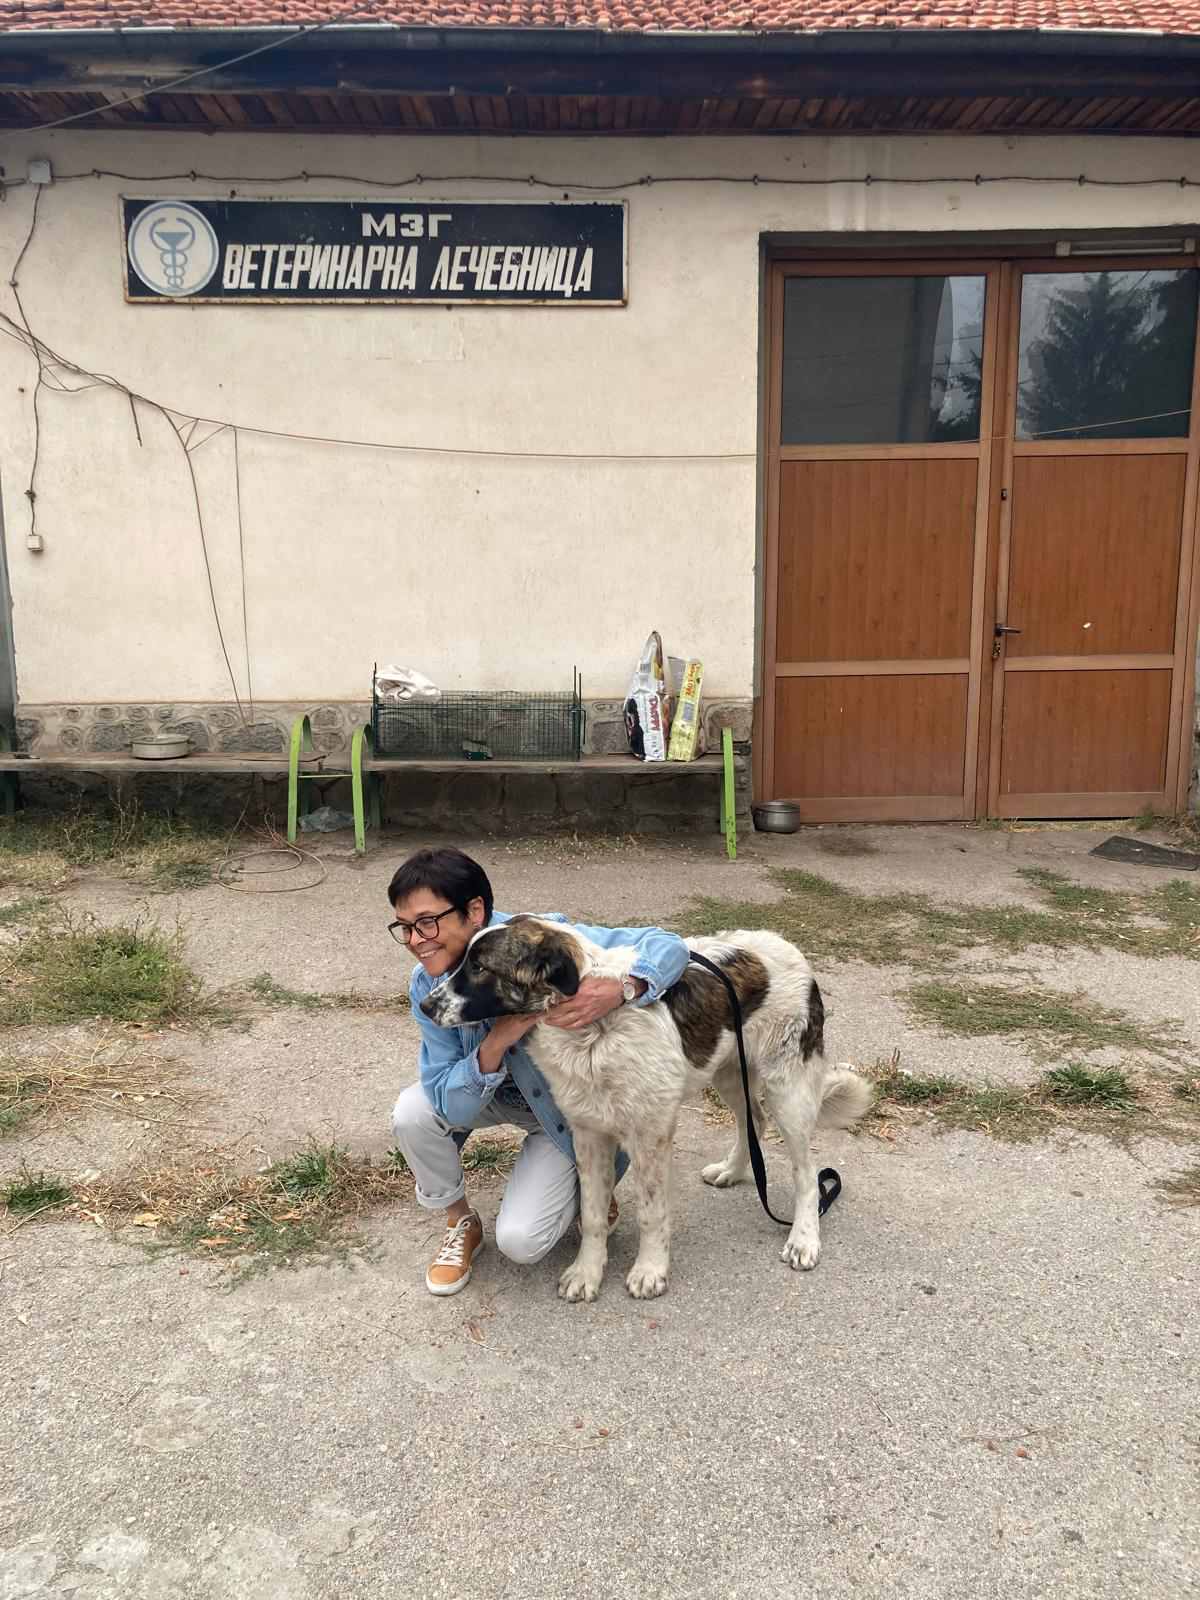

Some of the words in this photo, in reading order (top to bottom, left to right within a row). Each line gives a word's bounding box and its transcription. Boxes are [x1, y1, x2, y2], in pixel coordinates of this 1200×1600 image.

[362, 213, 452, 238] МЗГ
[223, 244, 418, 291] ВЕТЕРИНАРНА
[431, 246, 594, 298] ЛЕЧЕБНИЦА
